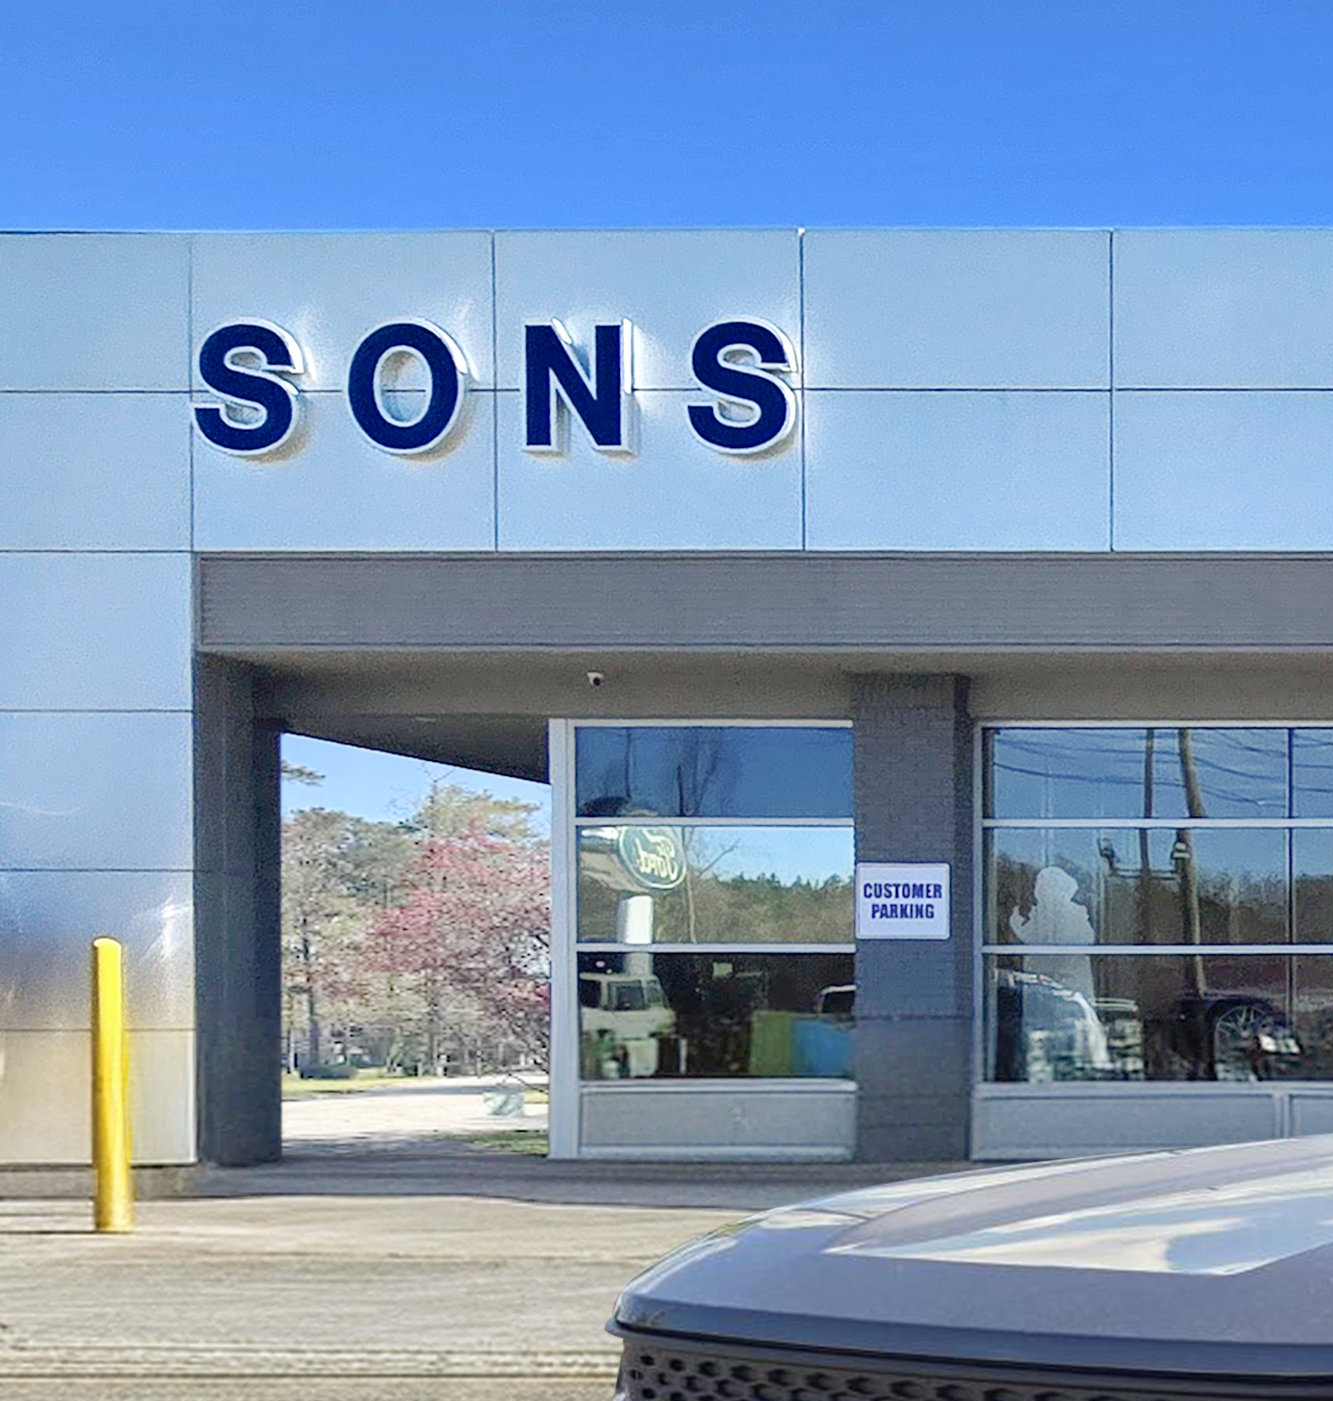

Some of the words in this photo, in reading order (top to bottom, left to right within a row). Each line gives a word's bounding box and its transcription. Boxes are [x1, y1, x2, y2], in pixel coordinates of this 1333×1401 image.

[194, 322, 797, 452] SONS
[863, 882, 943, 899] CUSTOMER
[871, 903, 935, 920] PARKING
